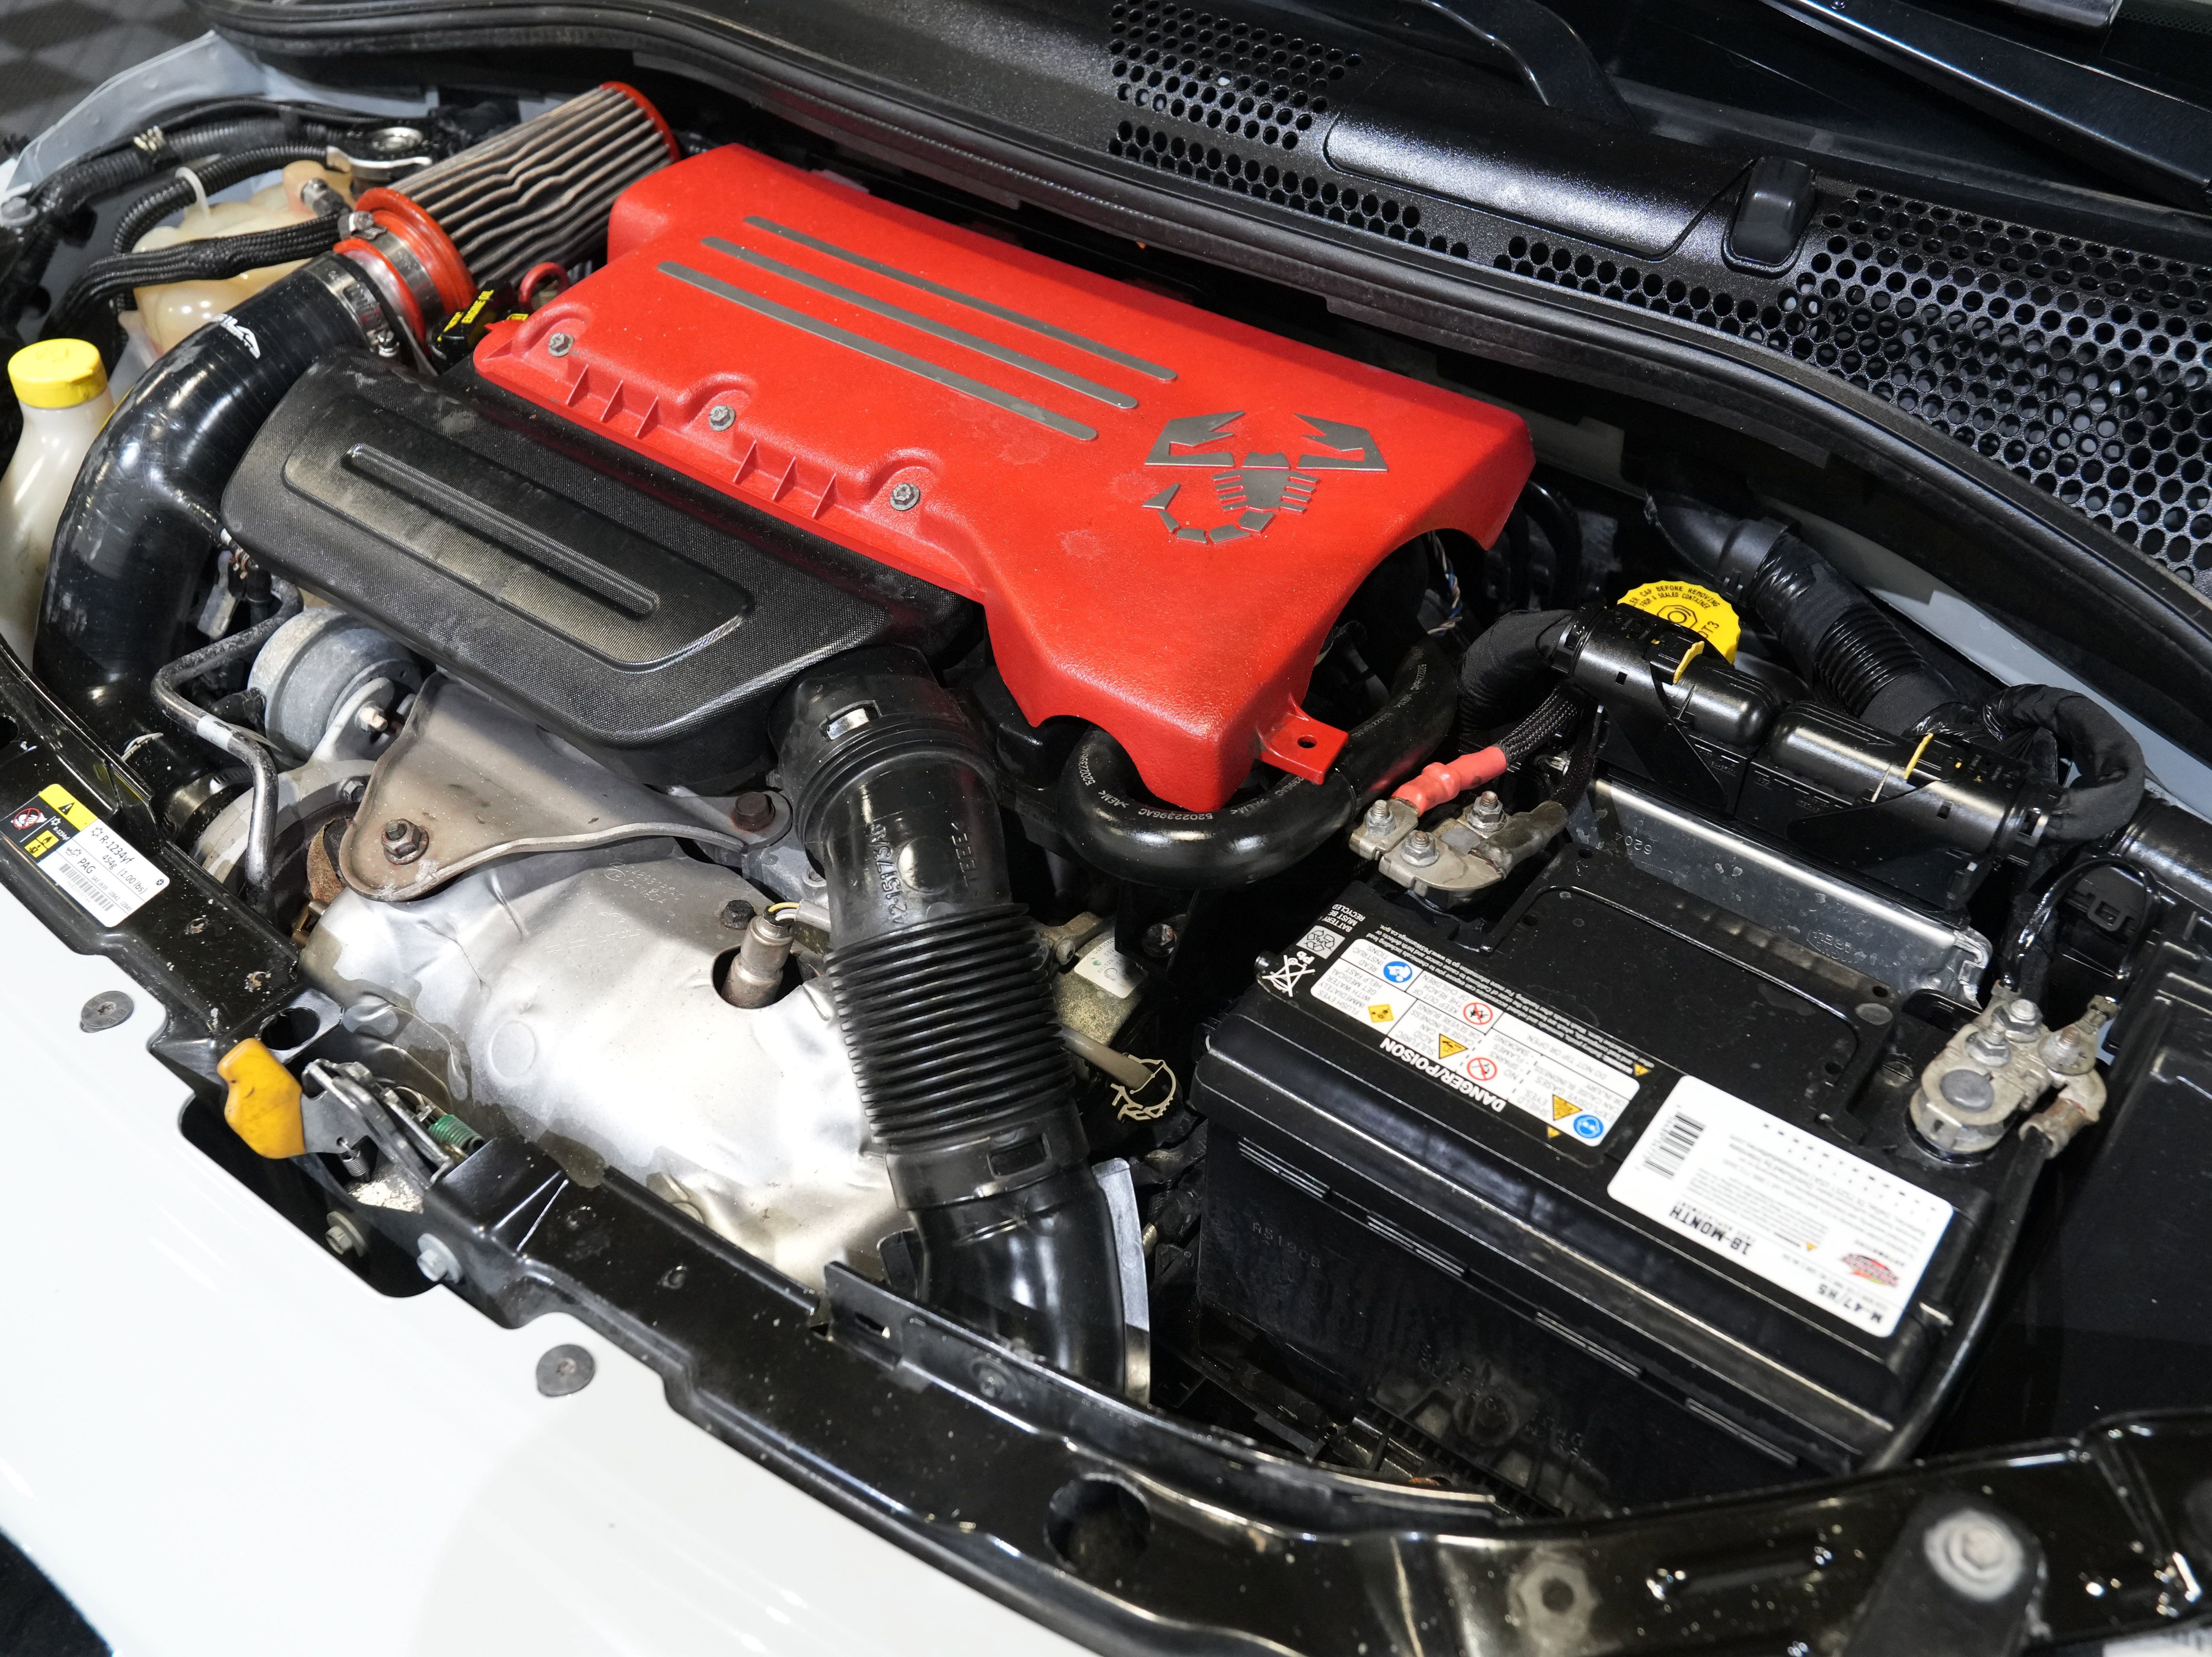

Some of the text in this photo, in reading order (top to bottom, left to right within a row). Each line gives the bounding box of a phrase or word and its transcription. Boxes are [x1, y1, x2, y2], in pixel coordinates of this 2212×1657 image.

[461, 289, 494, 324] ENGINE OIL
[1640, 588, 1652, 597] CAP
[1688, 588, 1721, 609] REMOVING.
[1641, 598, 1652, 607] FROM
[1682, 593, 1711, 610] CONTAINER.
[1138, 808, 1214, 821] 52022396AC
[52, 826, 71, 841] R-1234yf
[99, 835, 135, 864] R-1234yf
[76, 857, 96, 874] PAG
[99, 853, 148, 895] 454g (1.00 lbs)
[98, 881, 108, 890] J639
[108, 890, 120, 901] J2842
[120, 901, 132, 912] J2845
[1327, 909, 1358, 926] MUST BE
[1331, 901, 1366, 923] RECYCLED
[1321, 914, 1353, 934] BATTERY
[1293, 950, 1316, 965] Pb
[1351, 946, 1384, 966] INSTRUC-
[1365, 944, 1389, 959] TIONS.
[1357, 959, 1379, 972] READ
[1325, 975, 1372, 1002] WITH WATER.
[1329, 968, 1378, 995] GET MEDICAL
[1343, 966, 1383, 989] HELP FAST.
[1421, 973, 1469, 1001] OF CHILDREN.
[1317, 989, 1361, 1015] FLUSH EYES
[1318, 980, 1367, 1008] IMMEDIATELY
[1411, 987, 1459, 1014] KEEP OUT OF
[1422, 983, 1463, 1007] THE REACH
[1410, 1009, 1475, 1046] CAUSE BLINDNESS
[1415, 1003, 1481, 1040] OR SEVERE BURNS.
[1418, 1023, 1436, 1035] CAN
[1394, 1030, 1437, 1055] SULFURIC
[1412, 1030, 1434, 1044] ACID
[1492, 1034, 1530, 1056] SMOKING
[1488, 1050, 1520, 1070] SPARKS
[1492, 1043, 1525, 1063] FLAMES
[1525, 1034, 1608, 1080] DO NOT TIP OR OPEN.
[1377, 1037, 1509, 1113] DANGER/POISON
[1502, 1068, 1520, 1080] NO
[1523, 1089, 1549, 1106] EYES.
[1532, 1064, 1622, 1114] CAN CAUSE BLINDNESS
[1533, 1075, 1616, 1122] EXPLOSIVE GASES
[1515, 1095, 1550, 1117] SHIELD
[1668, 1205, 1752, 1255] 18-MONTH
[1816, 1283, 1883, 1324] M-47/H5
